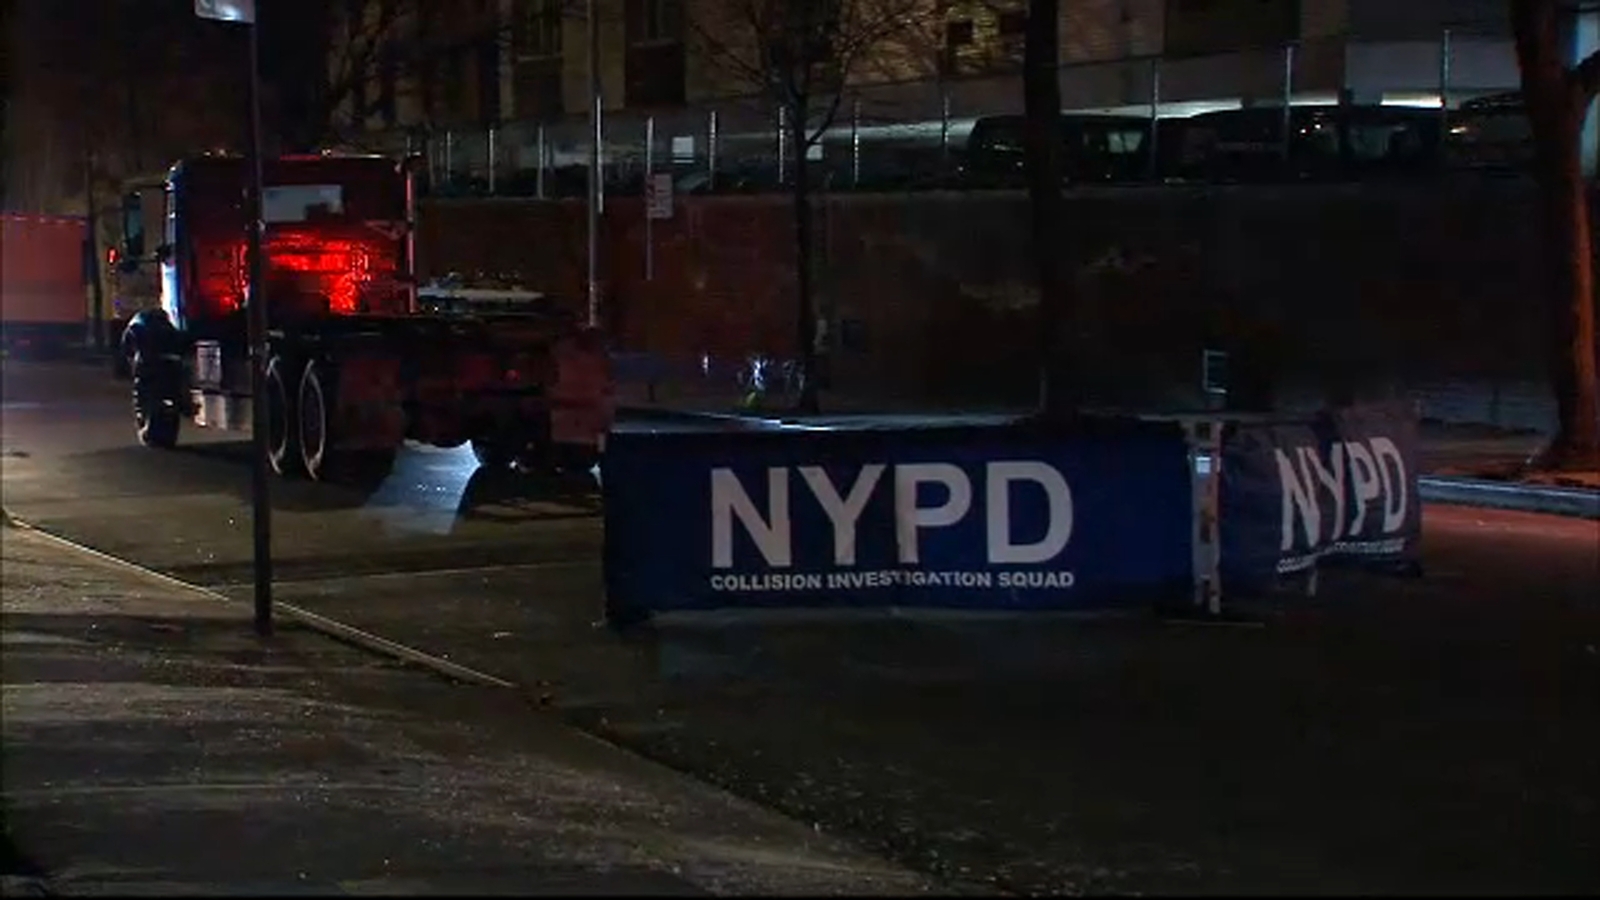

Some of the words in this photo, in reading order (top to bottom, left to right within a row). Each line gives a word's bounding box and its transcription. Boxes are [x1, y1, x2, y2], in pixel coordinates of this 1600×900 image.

[710, 461, 1074, 568] NYPD
[1275, 437, 1407, 551] NYPD
[710, 573, 822, 591] COLLISION
[827, 570, 992, 589] INVESTIGATION
[997, 571, 1075, 588] SQUAD
